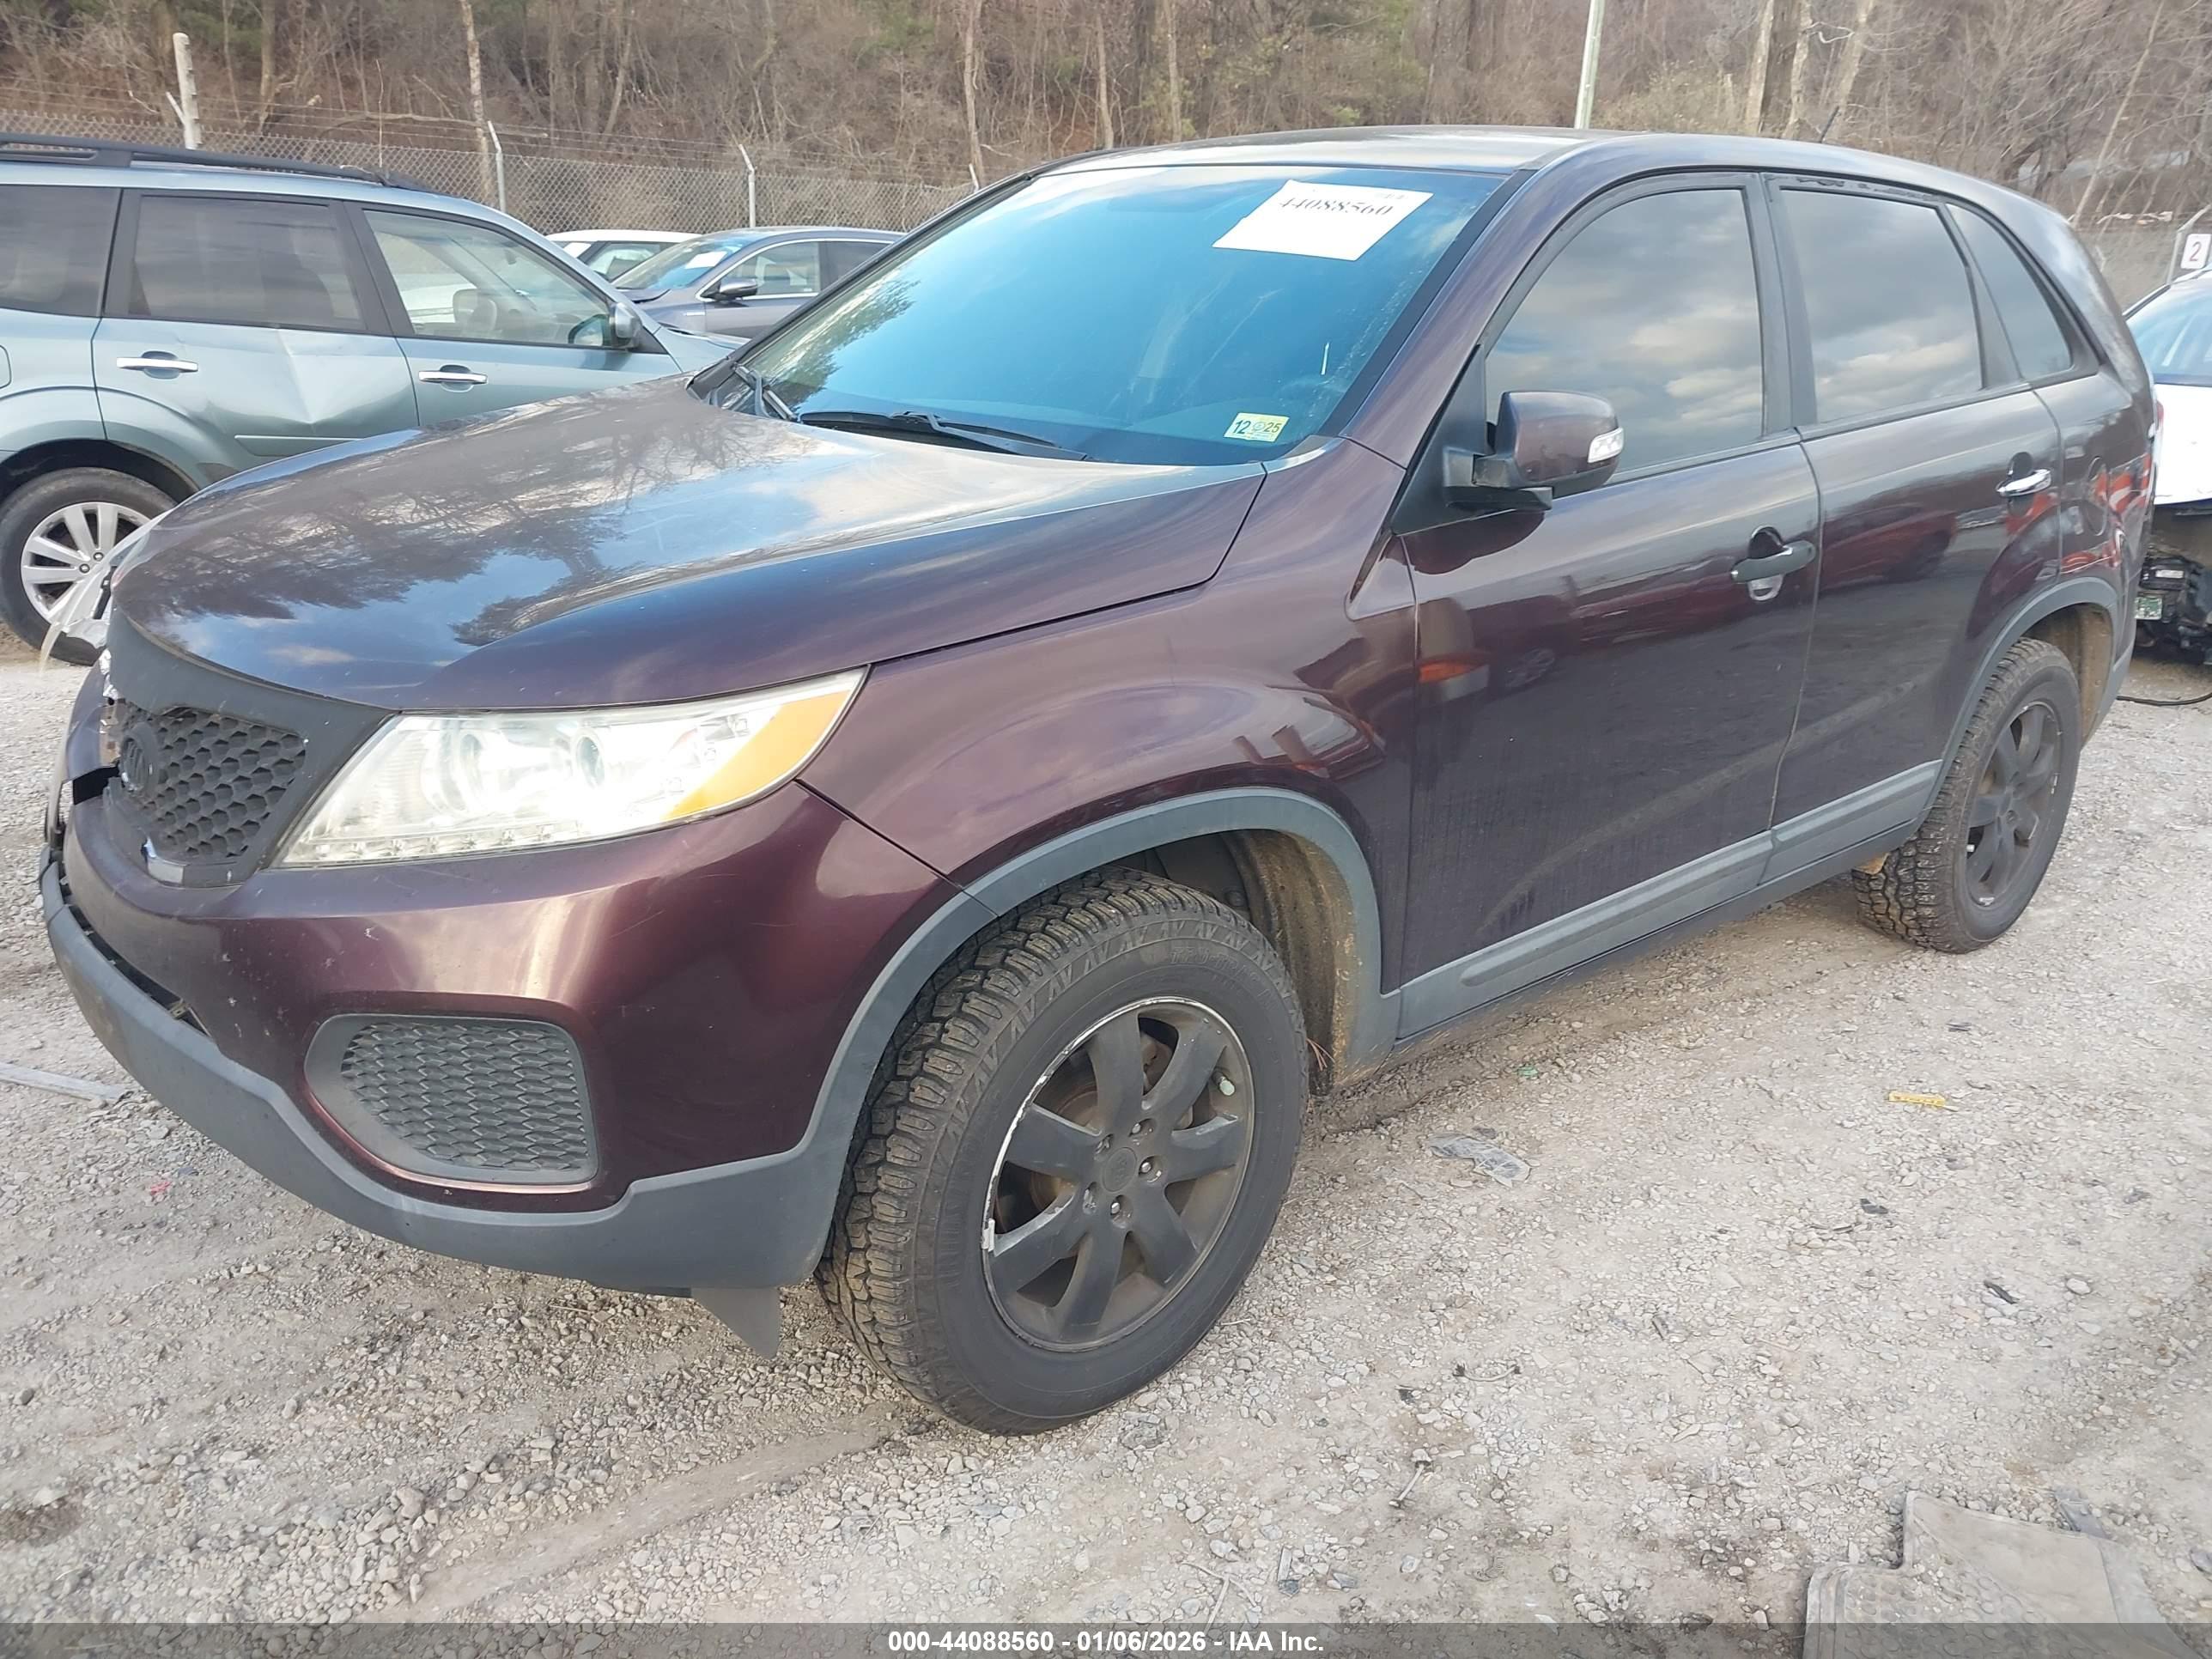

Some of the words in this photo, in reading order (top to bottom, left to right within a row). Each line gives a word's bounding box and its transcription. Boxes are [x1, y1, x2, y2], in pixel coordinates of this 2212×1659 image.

[1279, 198, 1394, 216] 44088560
[2188, 240, 2203, 262] 2
[1233, 420, 1251, 434] 12
[1264, 422, 1282, 433] 25
